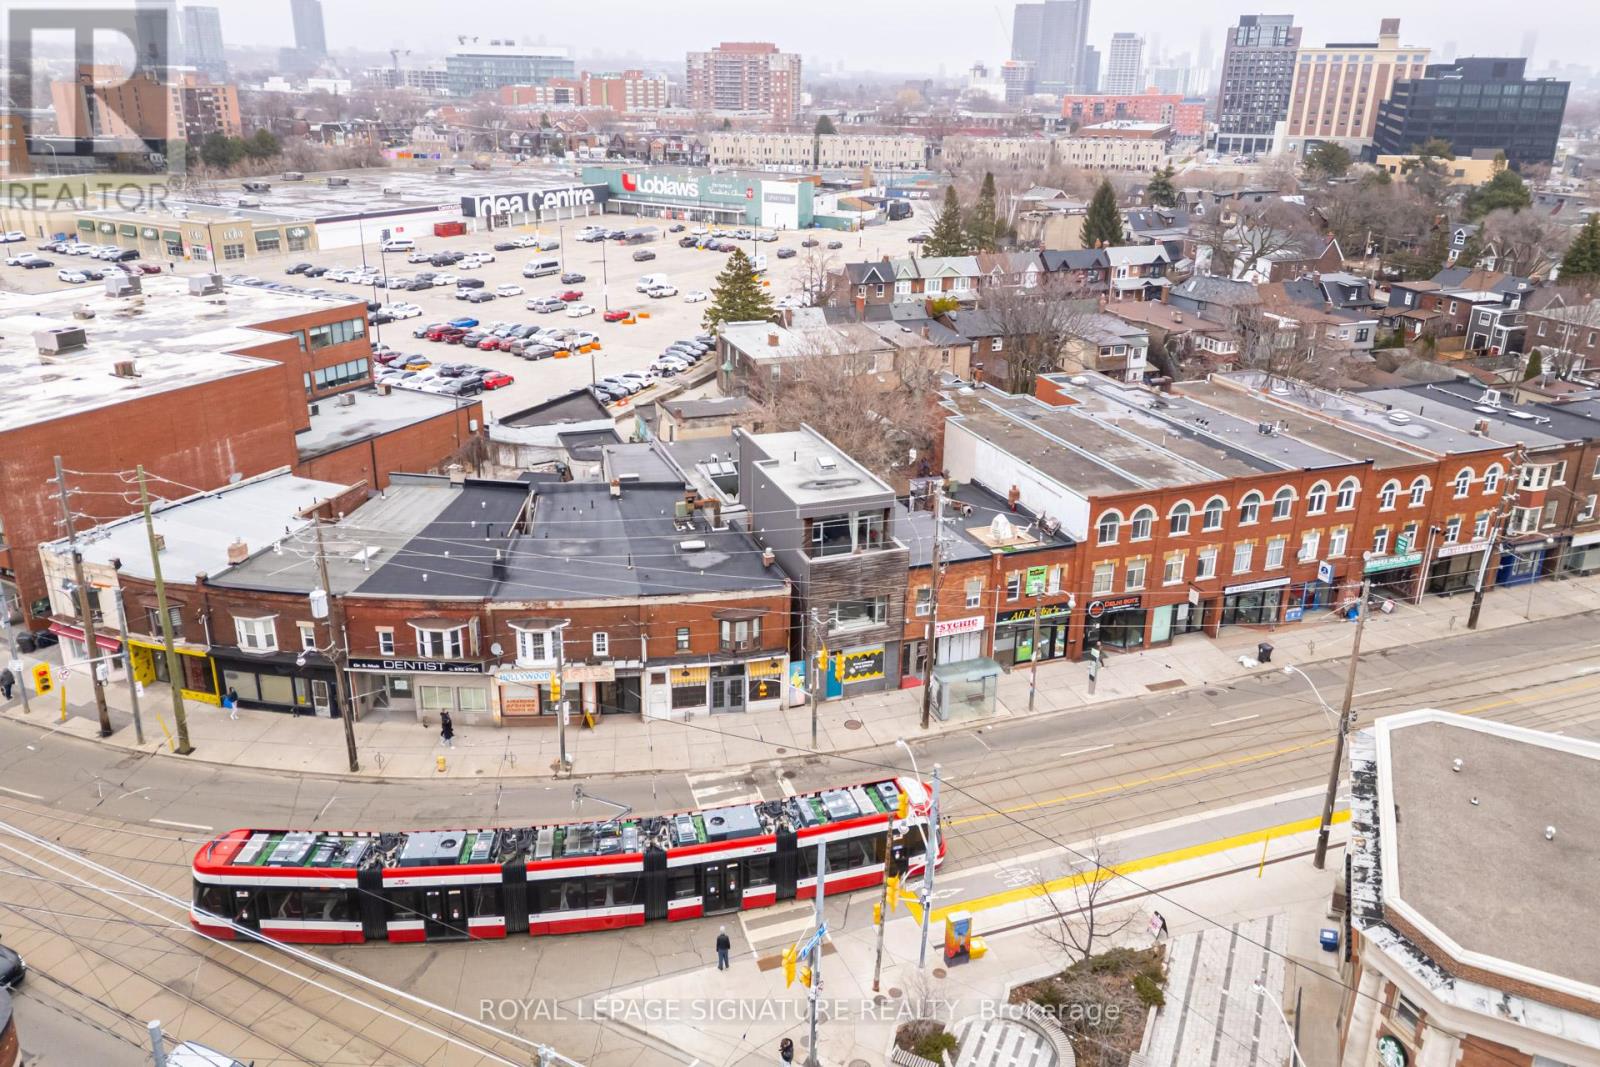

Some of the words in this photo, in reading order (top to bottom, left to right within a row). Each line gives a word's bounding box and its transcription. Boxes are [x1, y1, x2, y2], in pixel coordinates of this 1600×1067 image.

[637, 174, 699, 197] Loblaws
[474, 193, 524, 217] Idea
[527, 186, 595, 213] Centre
[1011, 611, 1025, 620] Ali
[383, 660, 445, 671] DENTIST
[500, 671, 550, 681] HOLLYWOOD
